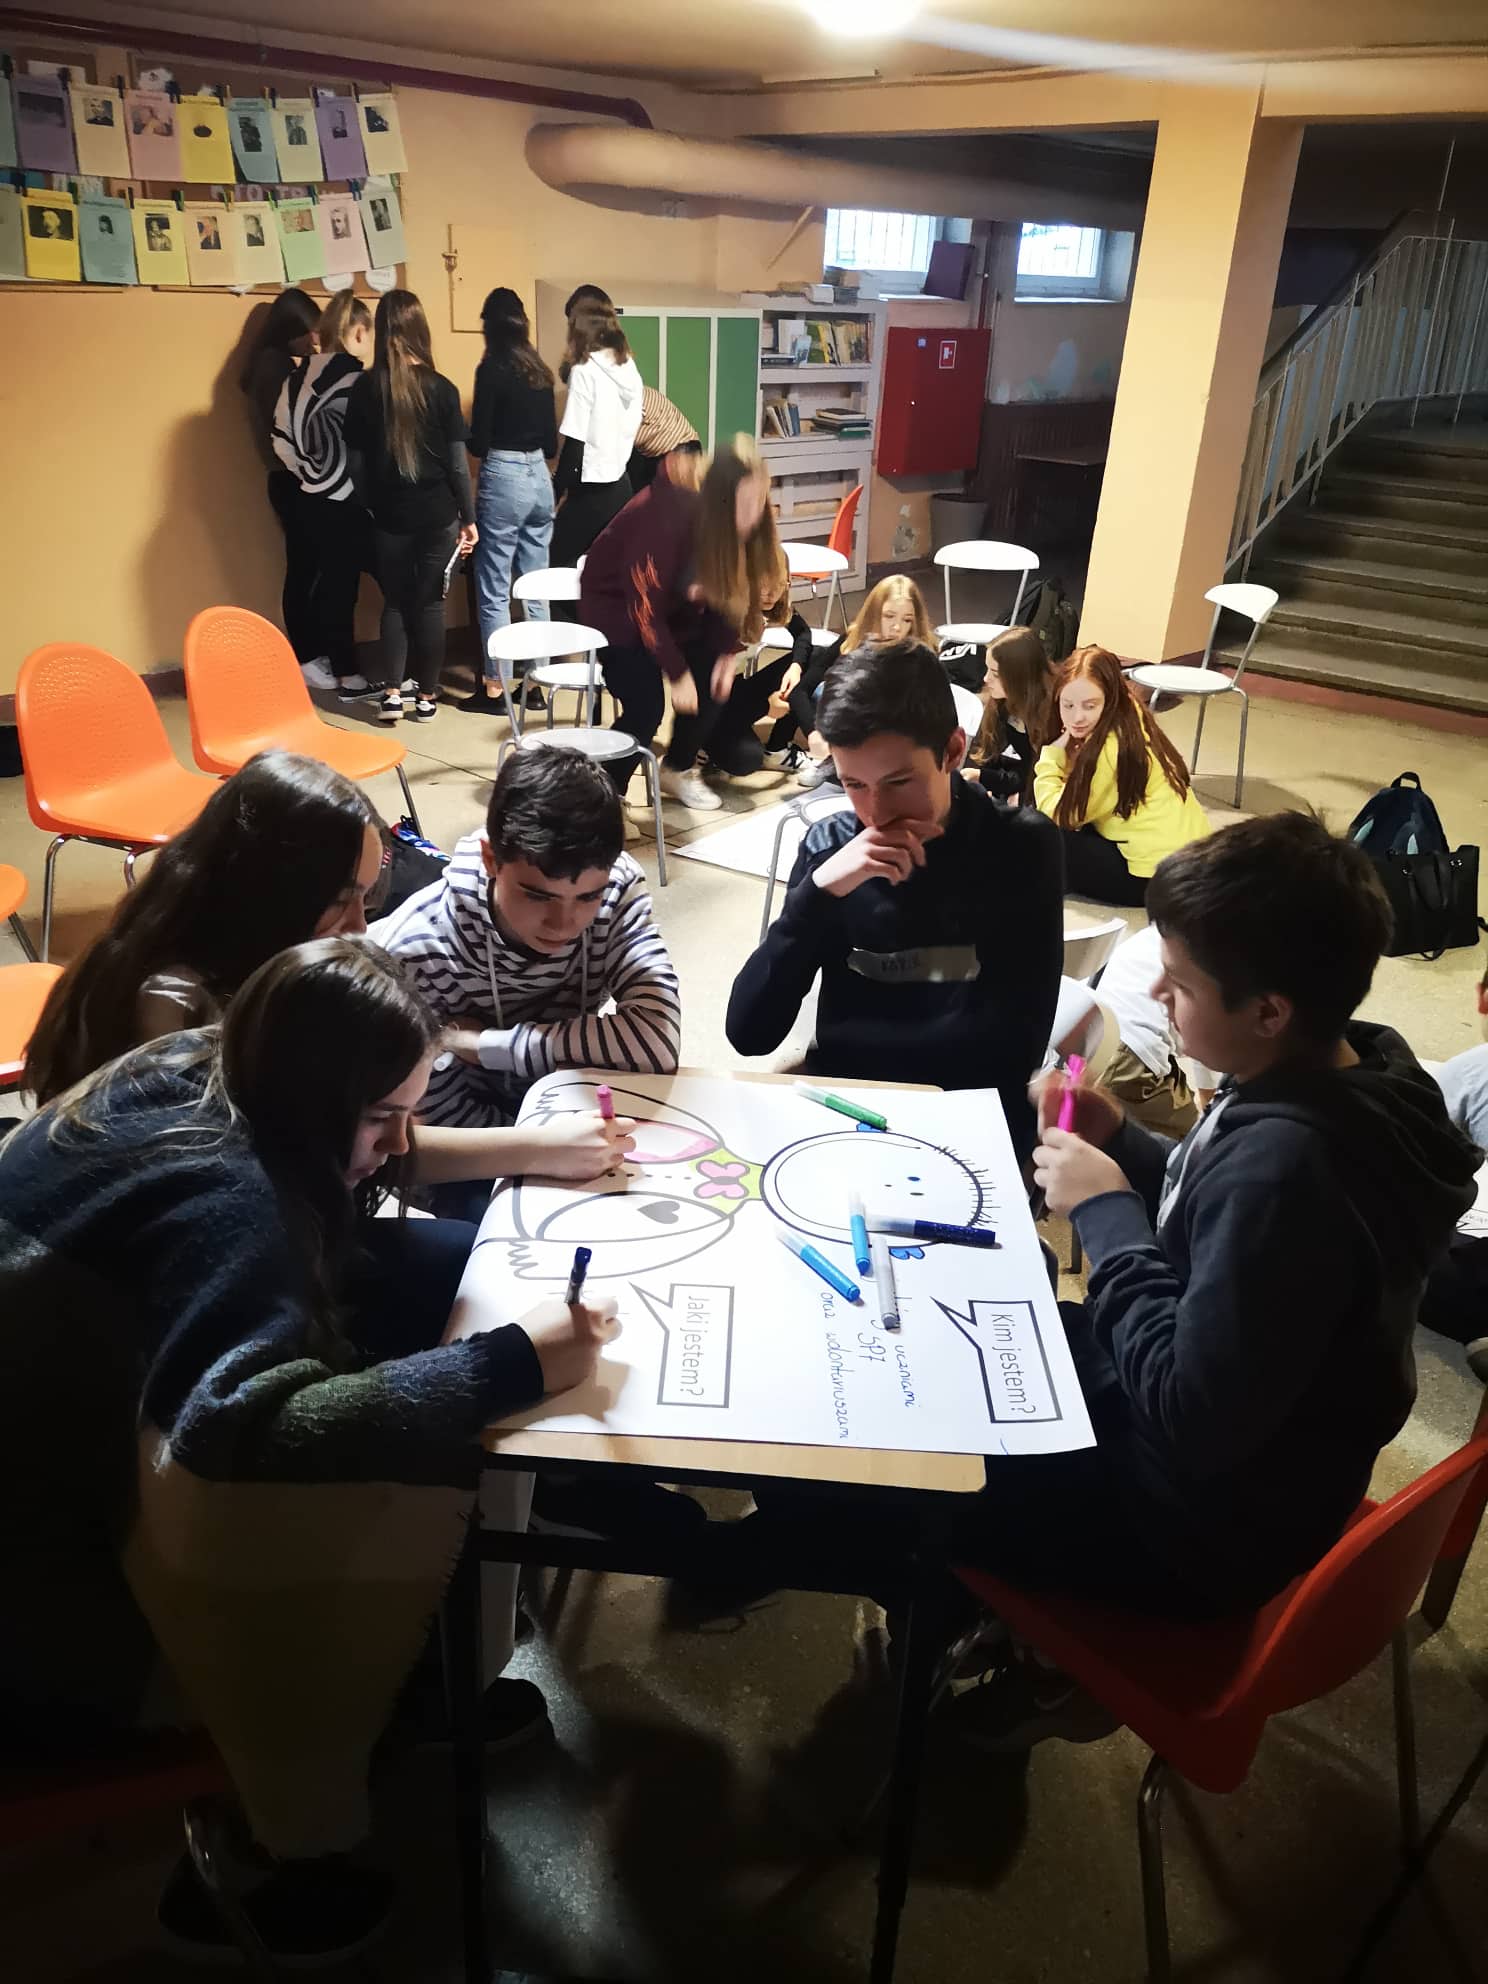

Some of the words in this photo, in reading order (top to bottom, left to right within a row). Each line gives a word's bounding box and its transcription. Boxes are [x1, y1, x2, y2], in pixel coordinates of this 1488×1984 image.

[686, 1295, 711, 1324] Jaki
[820, 1291, 836, 1319] oraz
[991, 1313, 1016, 1342] Kim
[680, 1327, 709, 1397] jestem?
[857, 1332, 887, 1363] SP7
[894, 1345, 919, 1408] uczniami
[991, 1346, 1037, 1414] jestem?
